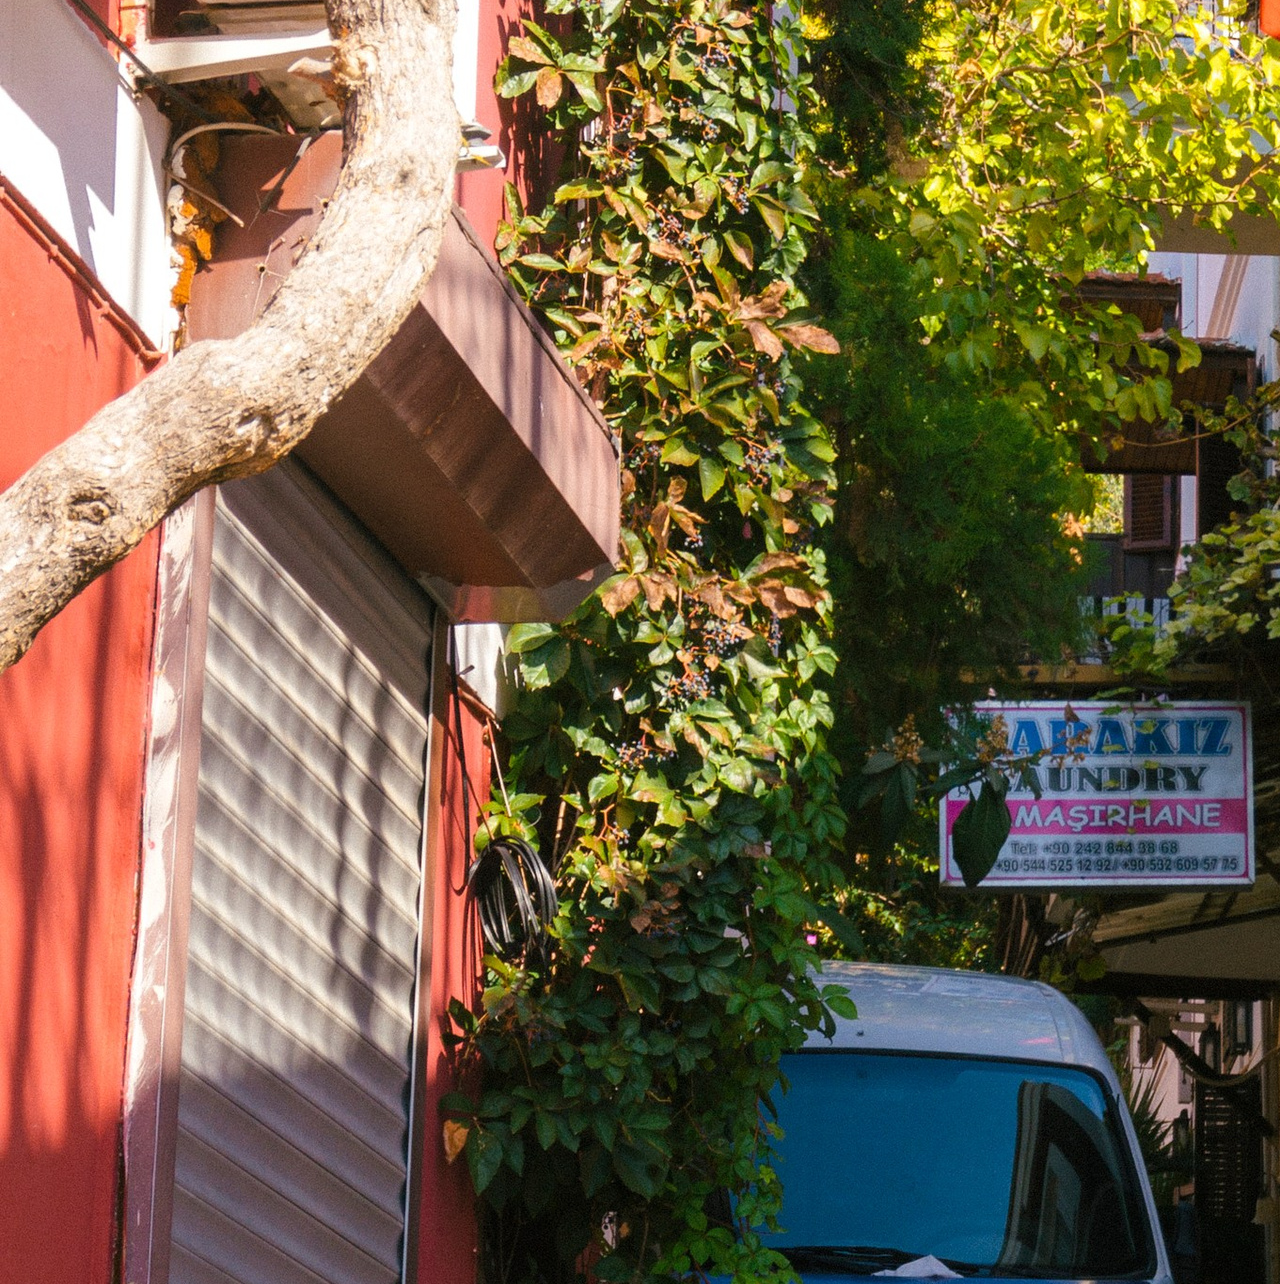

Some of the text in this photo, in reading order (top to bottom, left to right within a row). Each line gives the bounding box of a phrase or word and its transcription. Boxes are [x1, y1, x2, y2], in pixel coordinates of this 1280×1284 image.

[1000, 717, 1234, 757] ARAKIZ
[1000, 766, 1208, 793] AUNDRY
[1009, 803, 1222, 832] MAŞIRHANE
[1043, 842, 1069, 855] +90
[1075, 842, 1101, 855] 242
[1105, 841, 1133, 855] 844
[1160, 841, 1178, 855] 68
[1023, 859, 1045, 871] 544
[1050, 859, 1073, 871] 525
[1077, 859, 1091, 871] 12
[1176, 858, 1199, 871] 609
[1202, 858, 1217, 870] 57
[1221, 858, 1237, 870] 75
